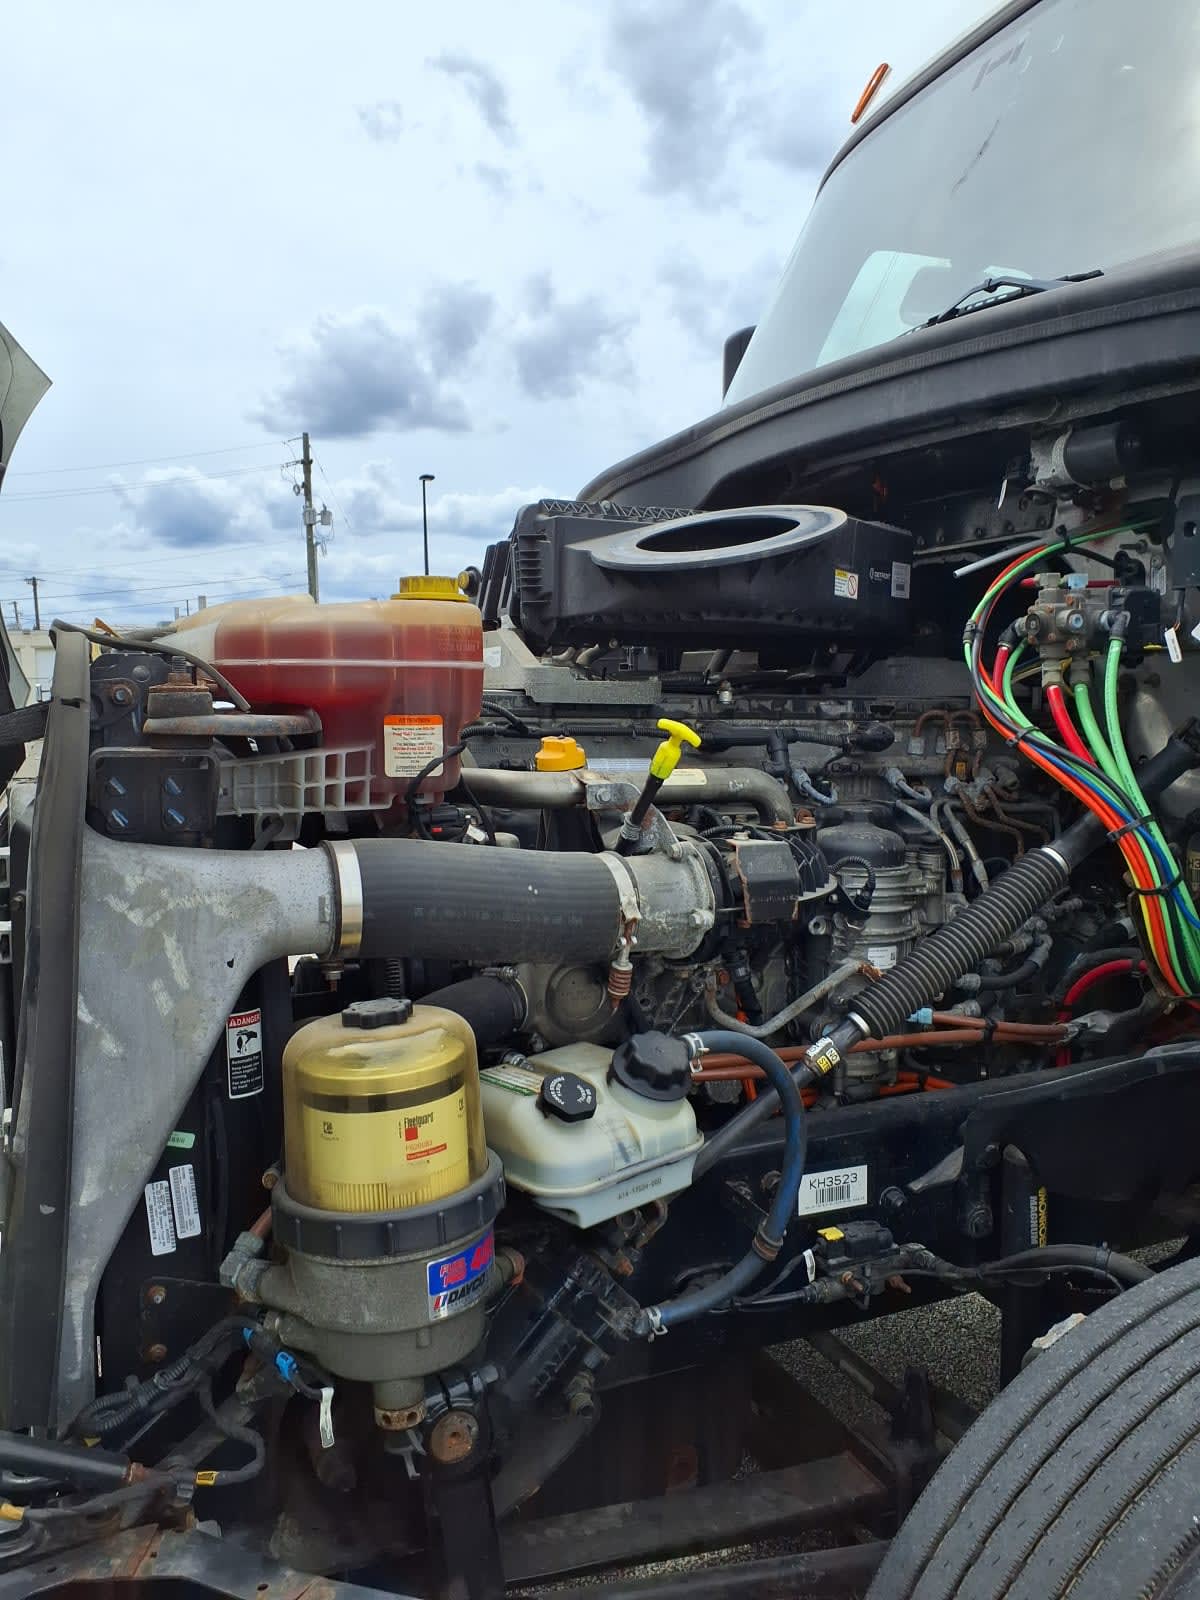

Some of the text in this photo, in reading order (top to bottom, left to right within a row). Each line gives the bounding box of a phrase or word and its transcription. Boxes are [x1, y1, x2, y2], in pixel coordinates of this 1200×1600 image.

[236, 1014, 260, 1026] DANGER
[827, 1049, 838, 1062] NO
[819, 1057, 832, 1072] STE
[404, 1111, 434, 1128] Fleetguard
[809, 1172, 858, 1191] KH3523
[1030, 1195, 1039, 1245] MAGNUM
[1039, 1190, 1047, 1248] MONROE
